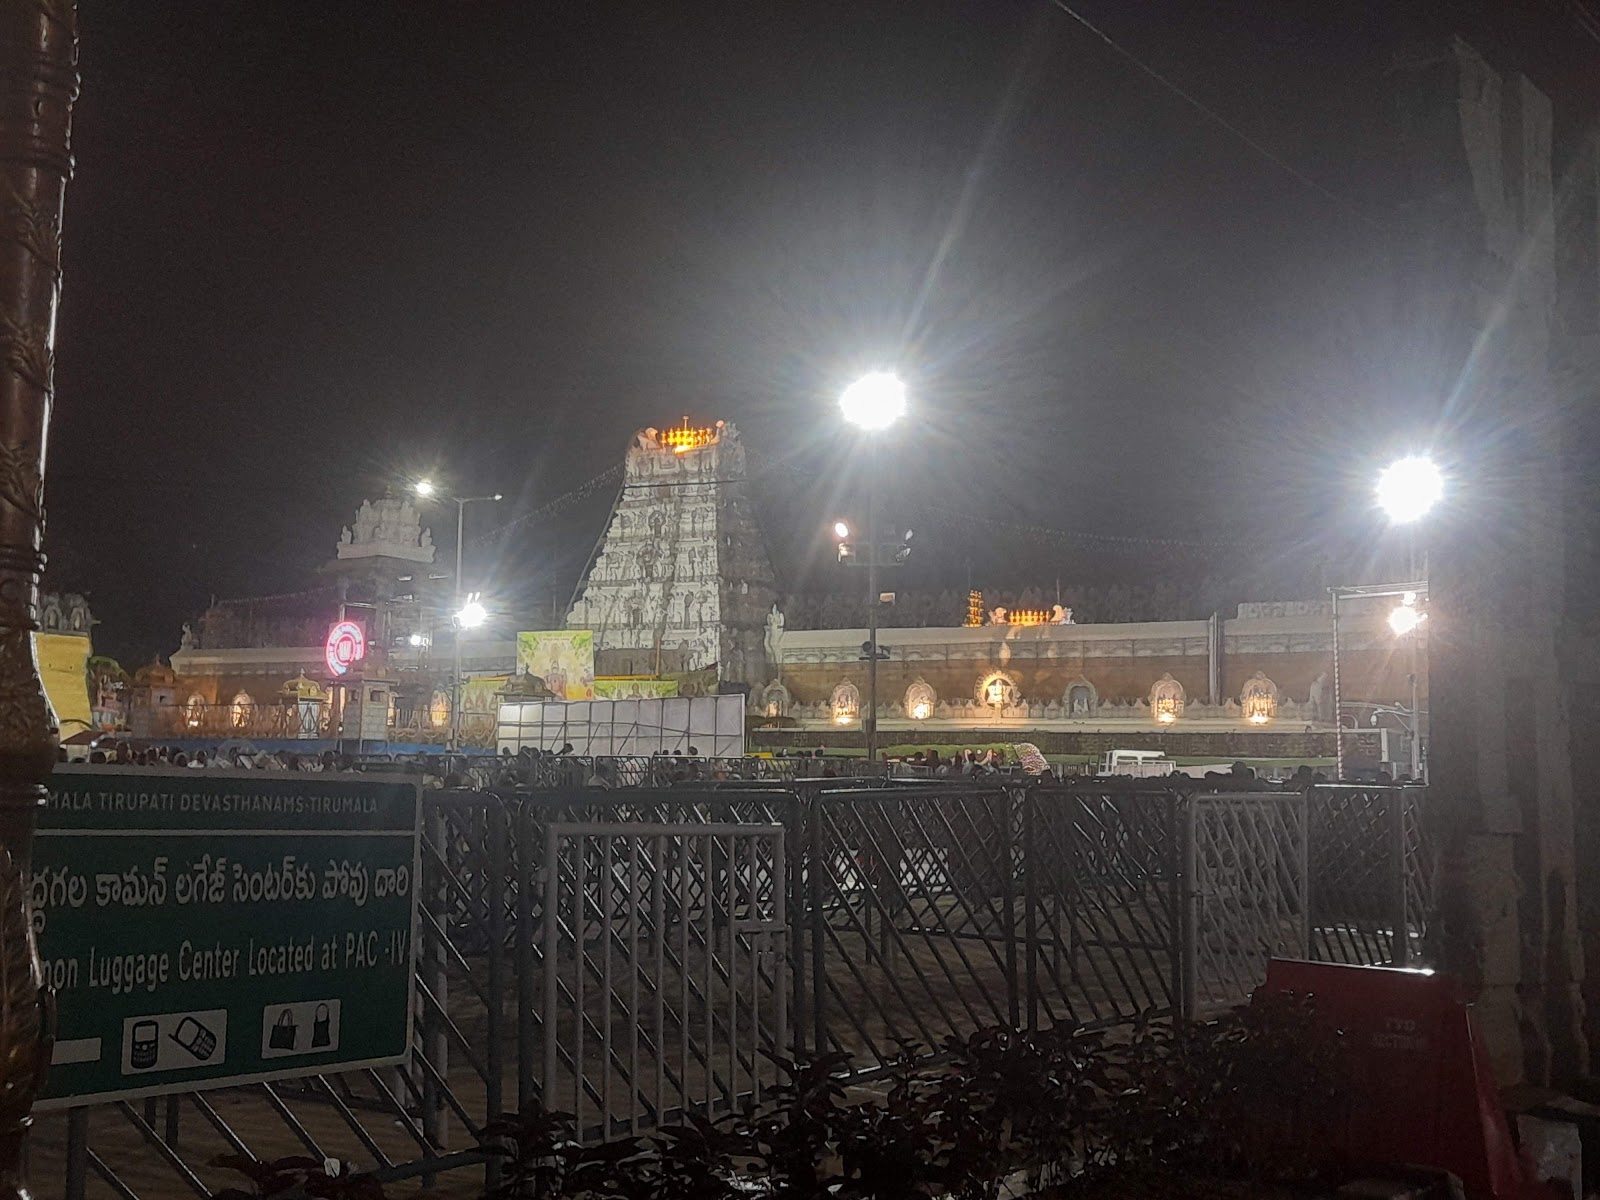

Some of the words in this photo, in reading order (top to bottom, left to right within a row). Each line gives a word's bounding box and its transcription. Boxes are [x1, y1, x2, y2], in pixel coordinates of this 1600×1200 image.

[46, 791, 93, 811] MALA
[98, 791, 173, 813] TIRUPATI
[96, 856, 169, 907] కామన్
[176, 853, 226, 904] లగేజ్
[321, 859, 369, 907] పోవు
[375, 864, 410, 898] దారి
[89, 947, 169, 994] Luggage
[178, 940, 240, 981] Center
[248, 933, 314, 973] Located
[321, 931, 339, 970] at
[345, 930, 379, 969] PAC
